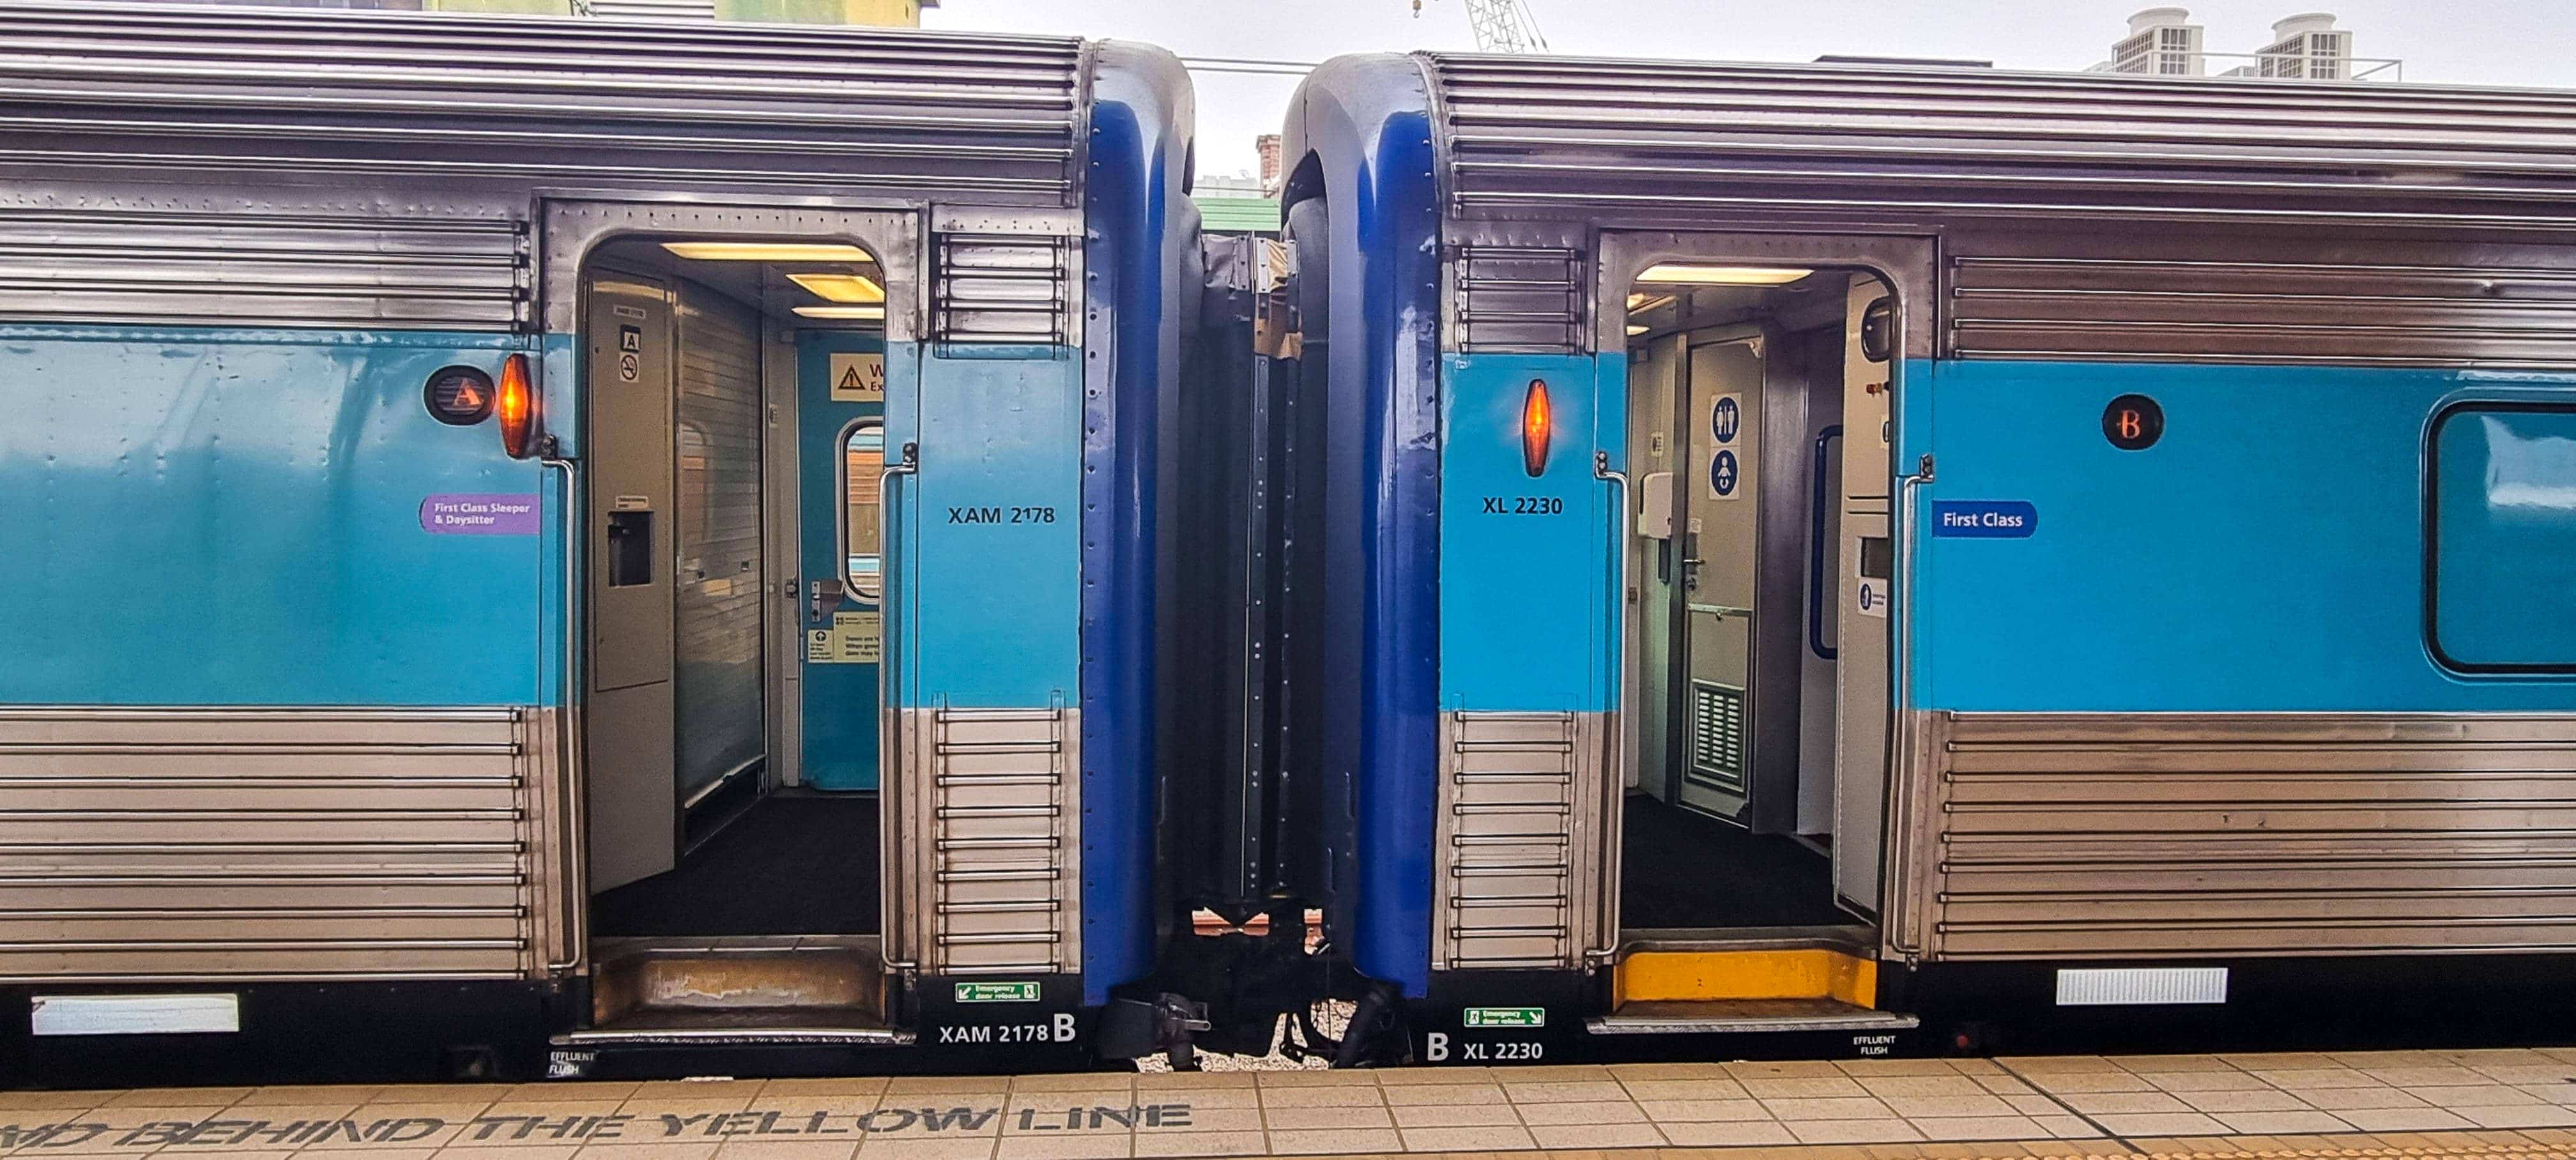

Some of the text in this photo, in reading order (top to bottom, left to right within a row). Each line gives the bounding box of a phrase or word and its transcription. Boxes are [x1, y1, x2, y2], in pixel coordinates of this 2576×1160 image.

[627, 334, 636, 348] A
[453, 378, 482, 406] A
[2121, 409, 2140, 439] B
[434, 503, 530, 514] First Class Sleeper
[1482, 497, 1563, 514] XL 2230
[434, 515, 495, 526] & Daysitter
[948, 507, 1055, 523] XAM 2178
[1943, 512, 2023, 527] First Class
[939, 1013, 1077, 1042] XAM 2178 B
[1427, 1032, 1543, 1061] B XL 2230
[1853, 1035, 1896, 1045] EFFLUENT
[550, 1051, 595, 1061] EFFLUENT
[1860, 1046, 1888, 1055] FLUSH
[549, 1064, 579, 1074] FLUSH
[112, 1118, 446, 1146] BEHIND
[468, 1114, 636, 1140] THE
[659, 1106, 1000, 1136] YELLOW
[1018, 1103, 1193, 1131] LINE
